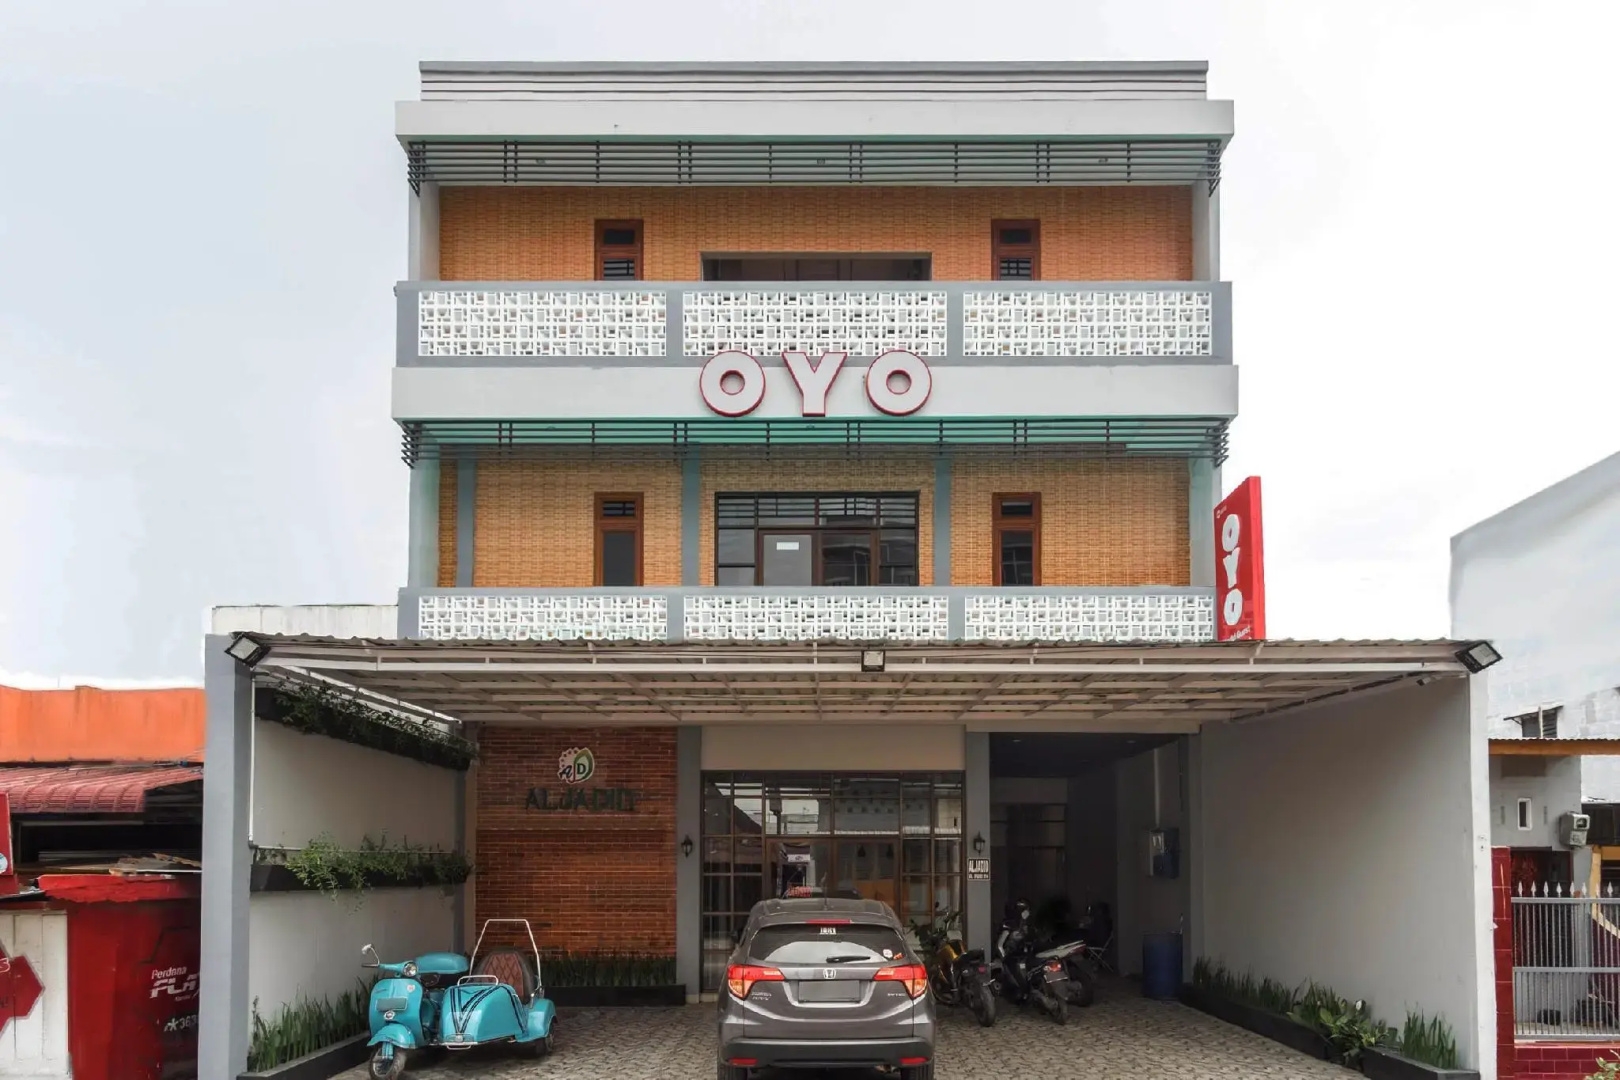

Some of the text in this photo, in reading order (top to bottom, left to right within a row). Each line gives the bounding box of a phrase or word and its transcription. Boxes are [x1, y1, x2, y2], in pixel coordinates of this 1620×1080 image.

[700, 350, 932, 417] OYO
[1221, 513, 1243, 626] OYO
[151, 966, 187, 980] Perdana
